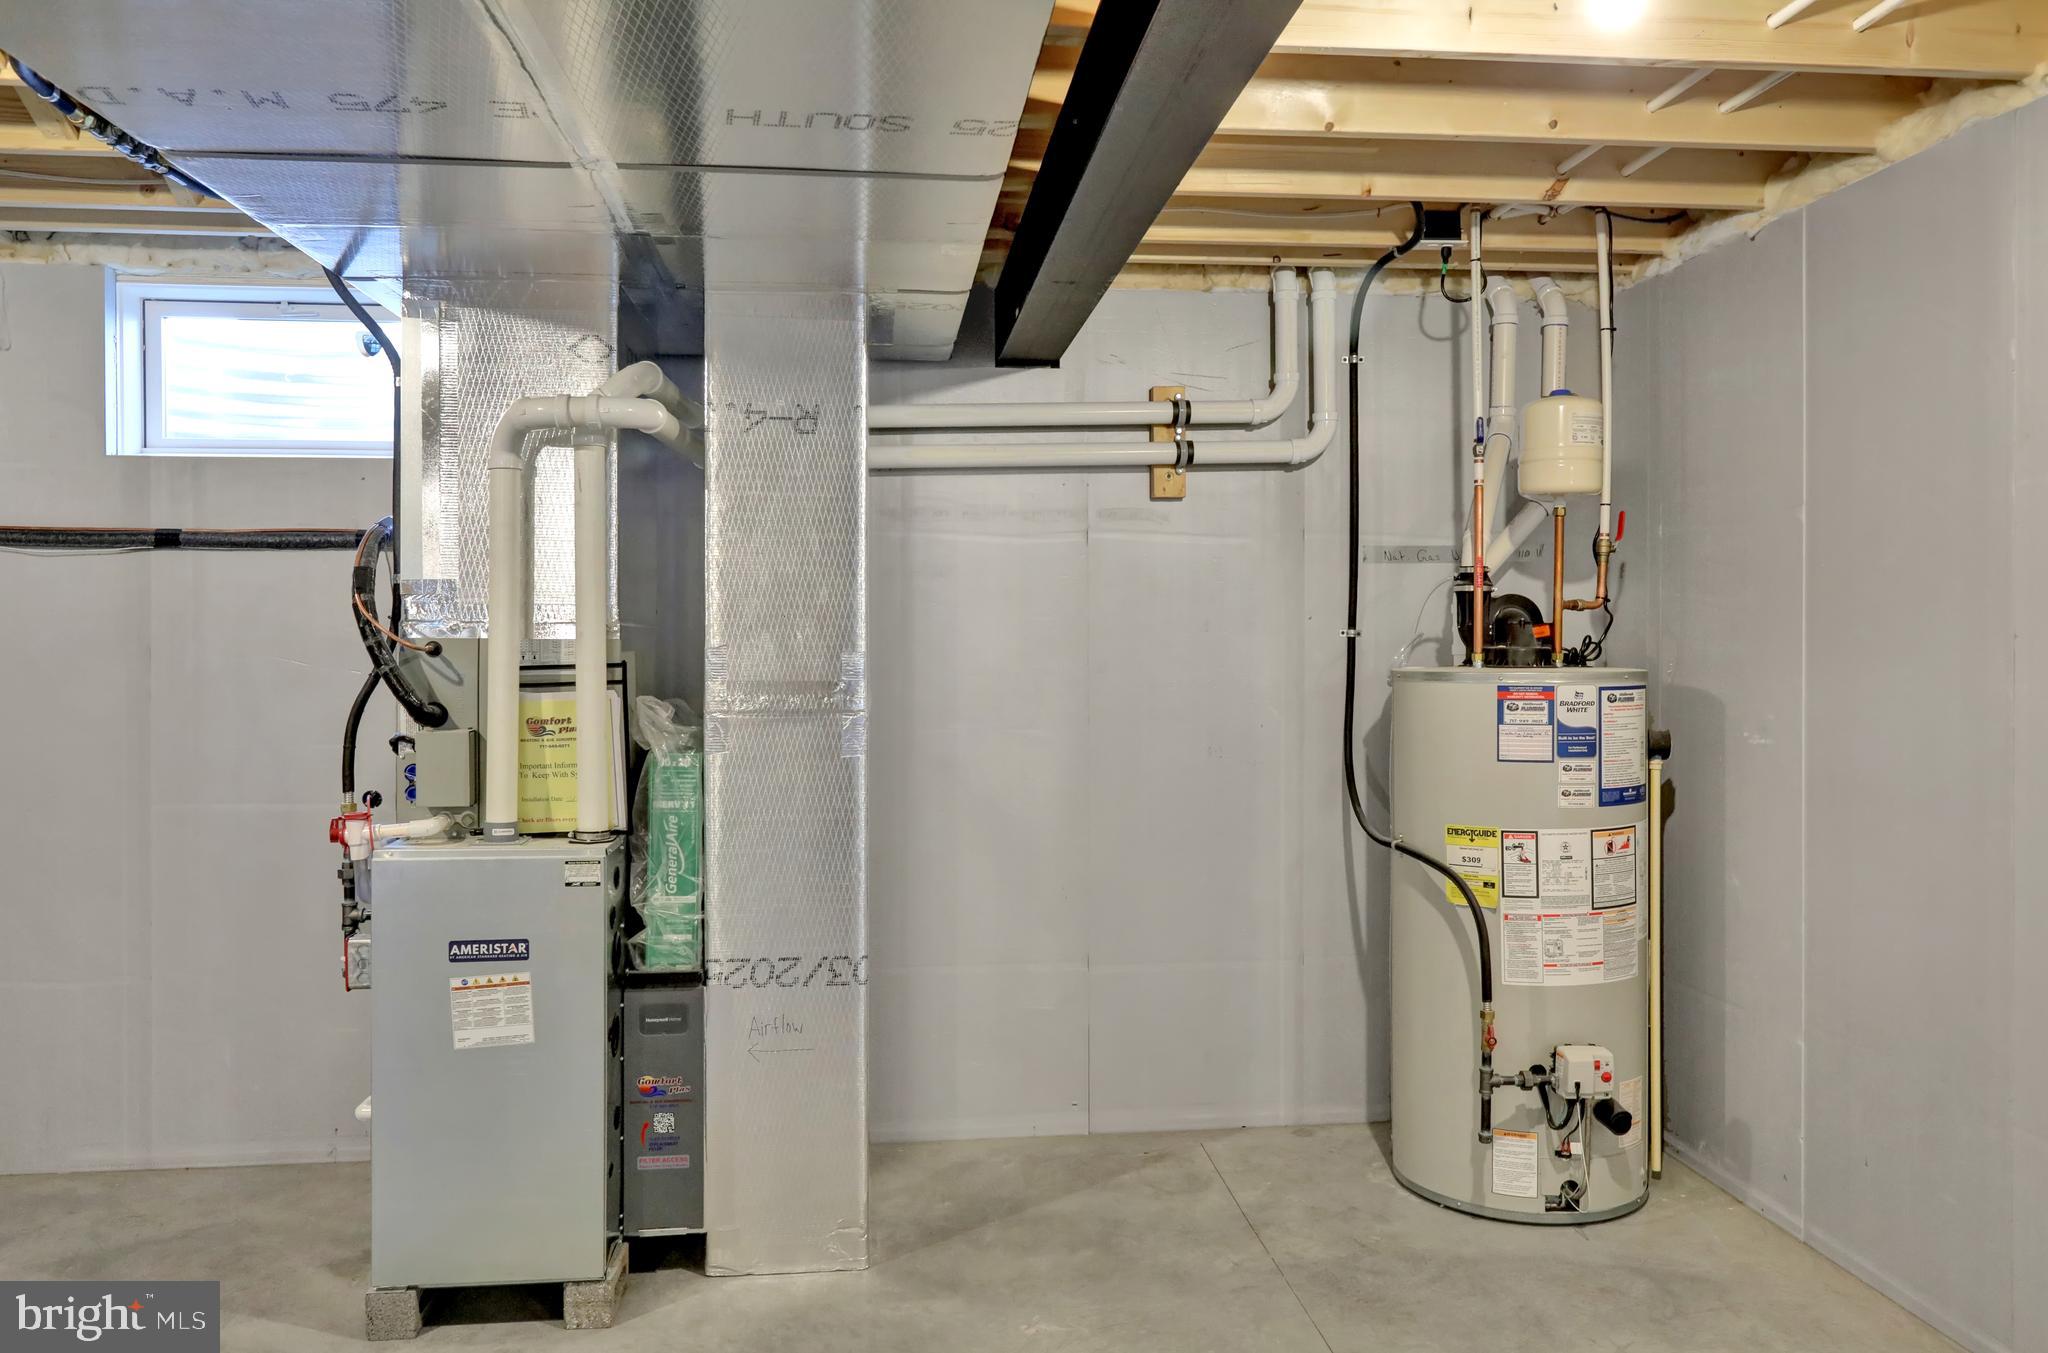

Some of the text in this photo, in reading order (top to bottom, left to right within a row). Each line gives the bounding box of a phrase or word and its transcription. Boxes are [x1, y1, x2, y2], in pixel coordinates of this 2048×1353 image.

[726, 109, 912, 132] SOUTH
[526, 716, 572, 725] Comfort
[520, 762, 552, 770] Important
[520, 771, 529, 779] To
[532, 771, 549, 780] Keep
[665, 815, 679, 894] GeneralAire
[1462, 856, 1481, 864] $309
[449, 943, 527, 956] AMERISTAR
[749, 1014, 803, 1040] Airflow
[637, 1076, 683, 1086] Comfort
